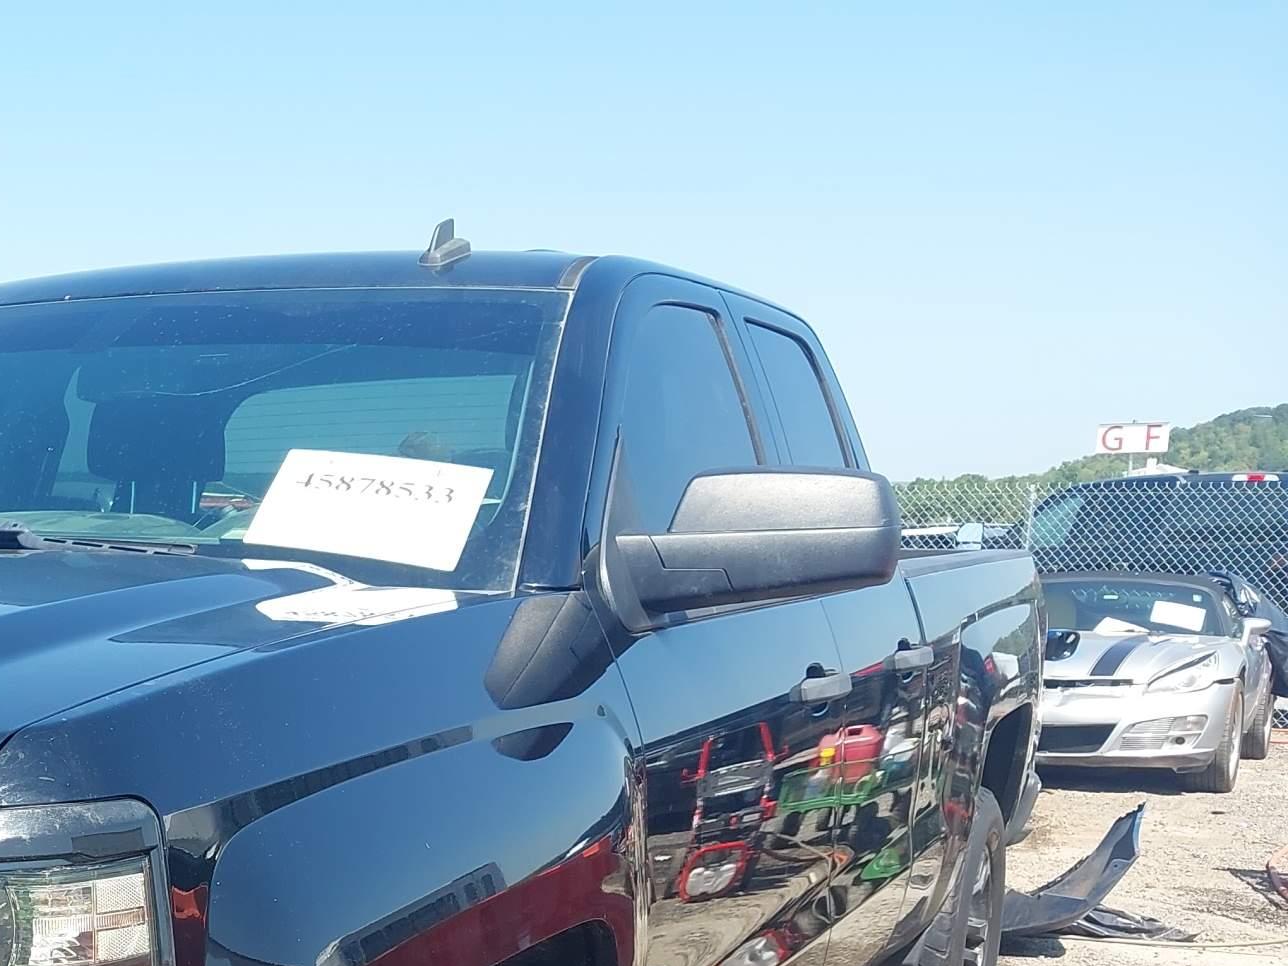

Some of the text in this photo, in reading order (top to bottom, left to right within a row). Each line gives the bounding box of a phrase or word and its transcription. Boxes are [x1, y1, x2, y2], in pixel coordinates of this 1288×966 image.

[1101, 424, 1163, 451] G F
[295, 473, 455, 503] 45878533
